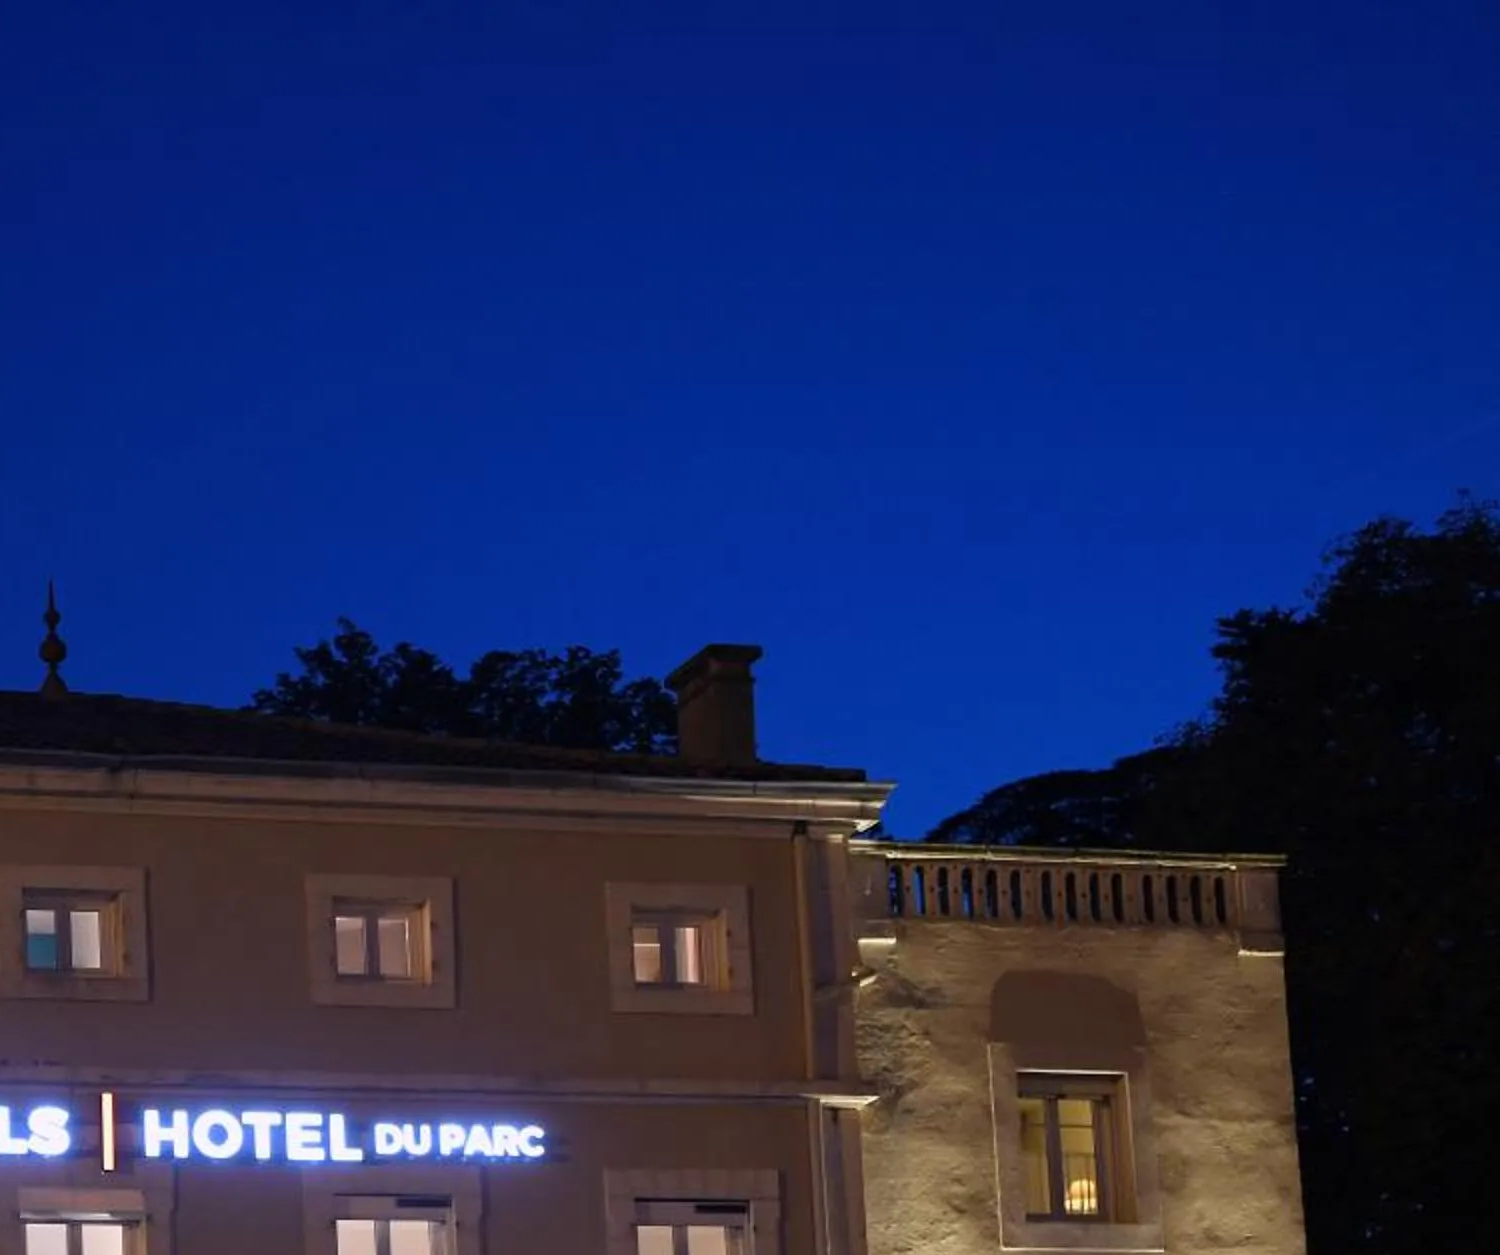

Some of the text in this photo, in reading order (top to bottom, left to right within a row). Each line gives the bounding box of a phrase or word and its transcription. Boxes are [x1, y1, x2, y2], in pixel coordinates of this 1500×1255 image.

[143, 1108, 363, 1161] HOTEL
[374, 1123, 431, 1156] DU
[439, 1123, 546, 1157] PARC
